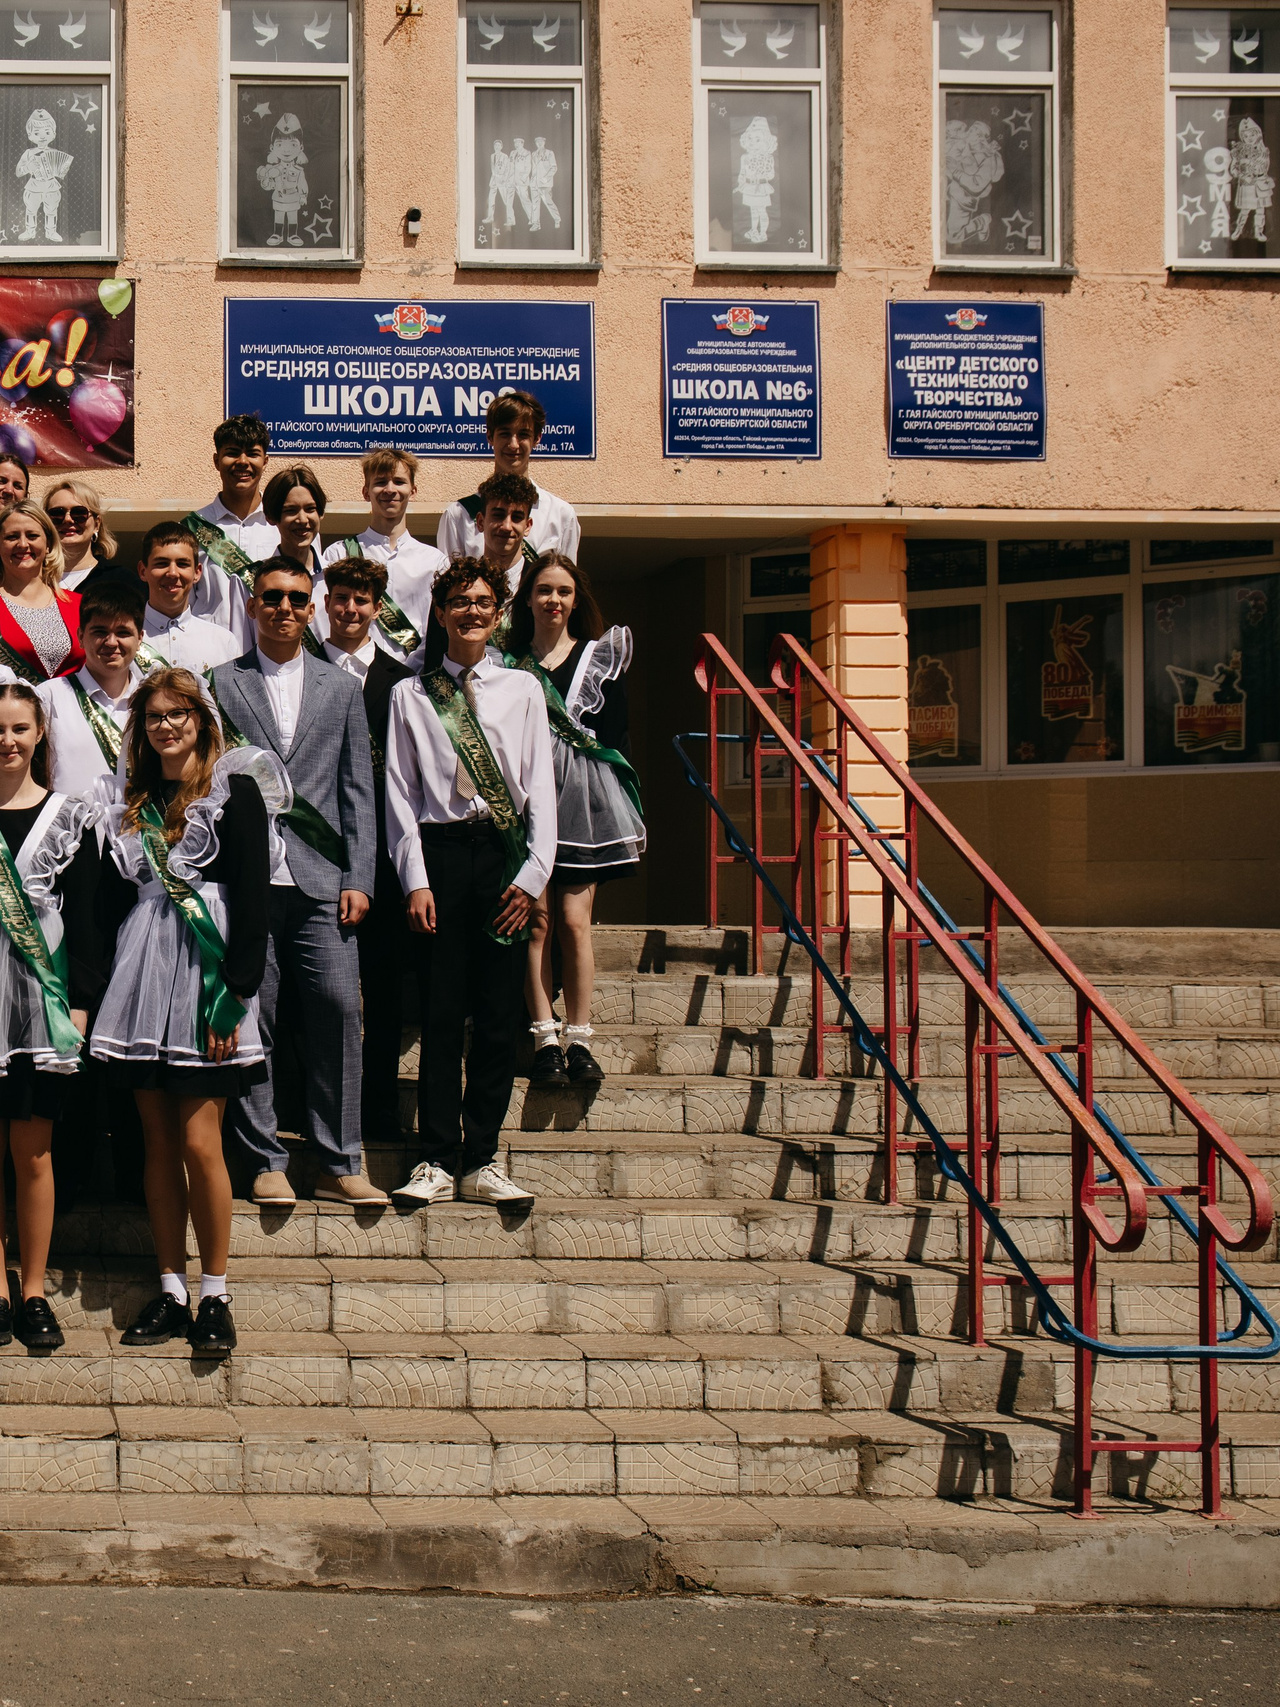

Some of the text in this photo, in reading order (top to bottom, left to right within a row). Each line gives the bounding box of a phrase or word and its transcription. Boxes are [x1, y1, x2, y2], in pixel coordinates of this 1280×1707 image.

[1203, 147, 1232, 184] 9
[1209, 184, 1231, 238] МАЯ
[894, 333, 1037, 343] МУНИЦИПАЛЬНОЕ БЮДЖЕТНОЕ УЧРЕЖДЕНИЕ
[240, 344, 580, 359] МУНИЦИПАЛЬНОЕ АВТОНОМНОЕ ОБЩЕОБРАЗОВАТЕЛЬНОЕ УЧРЕЖДЕНИЕ
[687, 348, 759, 356] ОБЩЕОБРАЗОВАТЕЛЬНОЕ
[910, 342, 975, 350] ДОПОЛНИТЕЛЬНОГО
[240, 360, 580, 382] СРЕДНЯЯ ОБЩЕОБРАЗОВАТЕЛЬНАЯ
[672, 363, 812, 373] «СРЕДНЯЯ ОБЩЕОБРАЗОВАТЕЛЬНАЯ
[896, 356, 1038, 373] «ЦЕНТР ДЕТСКОГО
[907, 373, 1028, 389] ТЕХНИЧЕСКОГО
[672, 379, 813, 401] ШКОЛА №6»
[304, 384, 442, 417] ШКОЛА
[914, 391, 1022, 406] ТВОРЧЕСТВА»
[673, 406, 813, 418] Г. ГАЯ ГАЙСКОГО МУНИЦИПАЛЬНОГО
[899, 408, 1038, 421] Г. ГАЯ ГАЙСКОГО МУНИЦИПАЛЬНОГО
[276, 421, 324, 432] ГАЙСКОГО
[326, 422, 416, 434] МУНИЦИПАЛЬНОГО
[418, 423, 454, 434] ОКРУГА
[540, 425, 575, 435] БЛАСТИ
[678, 417, 807, 429] ОКРУГА ОРЕНБУРГСКОЙ ОБЛАСТИ
[904, 421, 1033, 431] ОКРУГА ОРЕНБУРГСКОЙ ОБЛАСТИ
[278, 439, 330, 450] Оренбургская
[330, 440, 363, 450] область,
[365, 440, 394, 450] Гайский
[396, 441, 455, 451] муниципальный
[456, 443, 479, 452] округ,
[560, 443, 575, 452] 17А
[1044, 662, 1069, 683] 80
[1044, 686, 1091, 699] ПОБЕДА!
[908, 706, 956, 722] ПАСИБО
[1178, 704, 1242, 718] ГОРДИМСЯ!
[916, 720, 956, 732] ПОБЕДУ!
[481, 783, 518, 831] 2025
